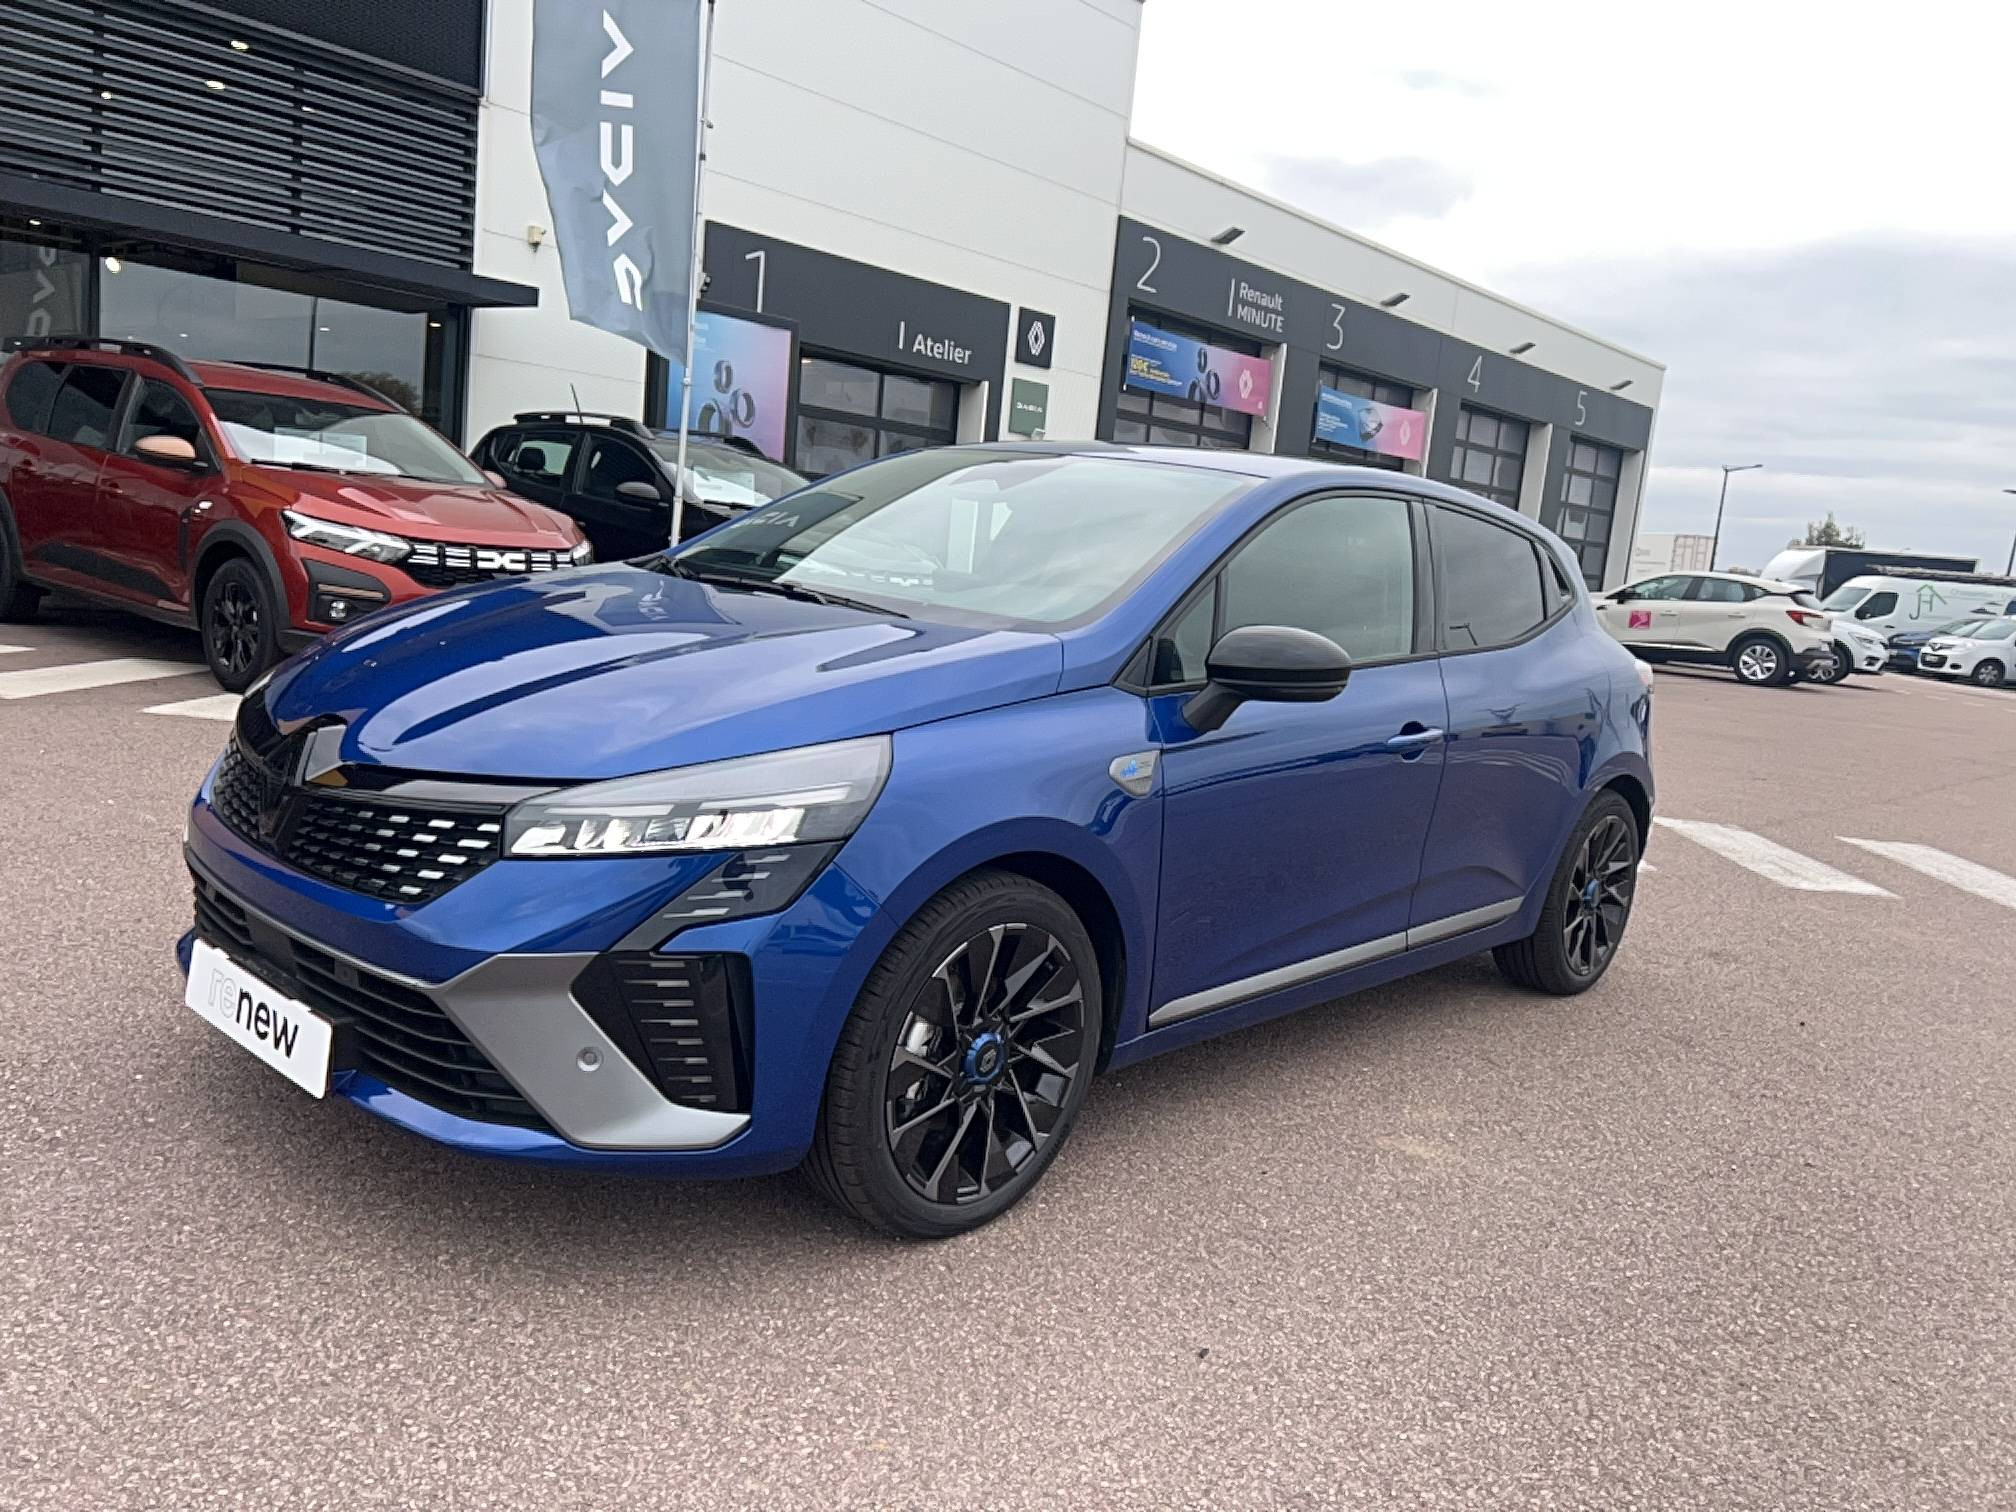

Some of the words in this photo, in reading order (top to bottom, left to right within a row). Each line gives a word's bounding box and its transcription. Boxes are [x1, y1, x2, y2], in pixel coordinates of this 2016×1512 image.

[744, 250, 766, 313] 1
[1136, 236, 1162, 294] 2
[1240, 281, 1283, 312] Renault
[1237, 303, 1285, 333] MINUTE
[1326, 303, 1346, 351] 3
[912, 333, 973, 365] Atelier
[1466, 355, 1483, 393] 4
[1574, 390, 1588, 426] 5
[208, 968, 300, 1060] renew
